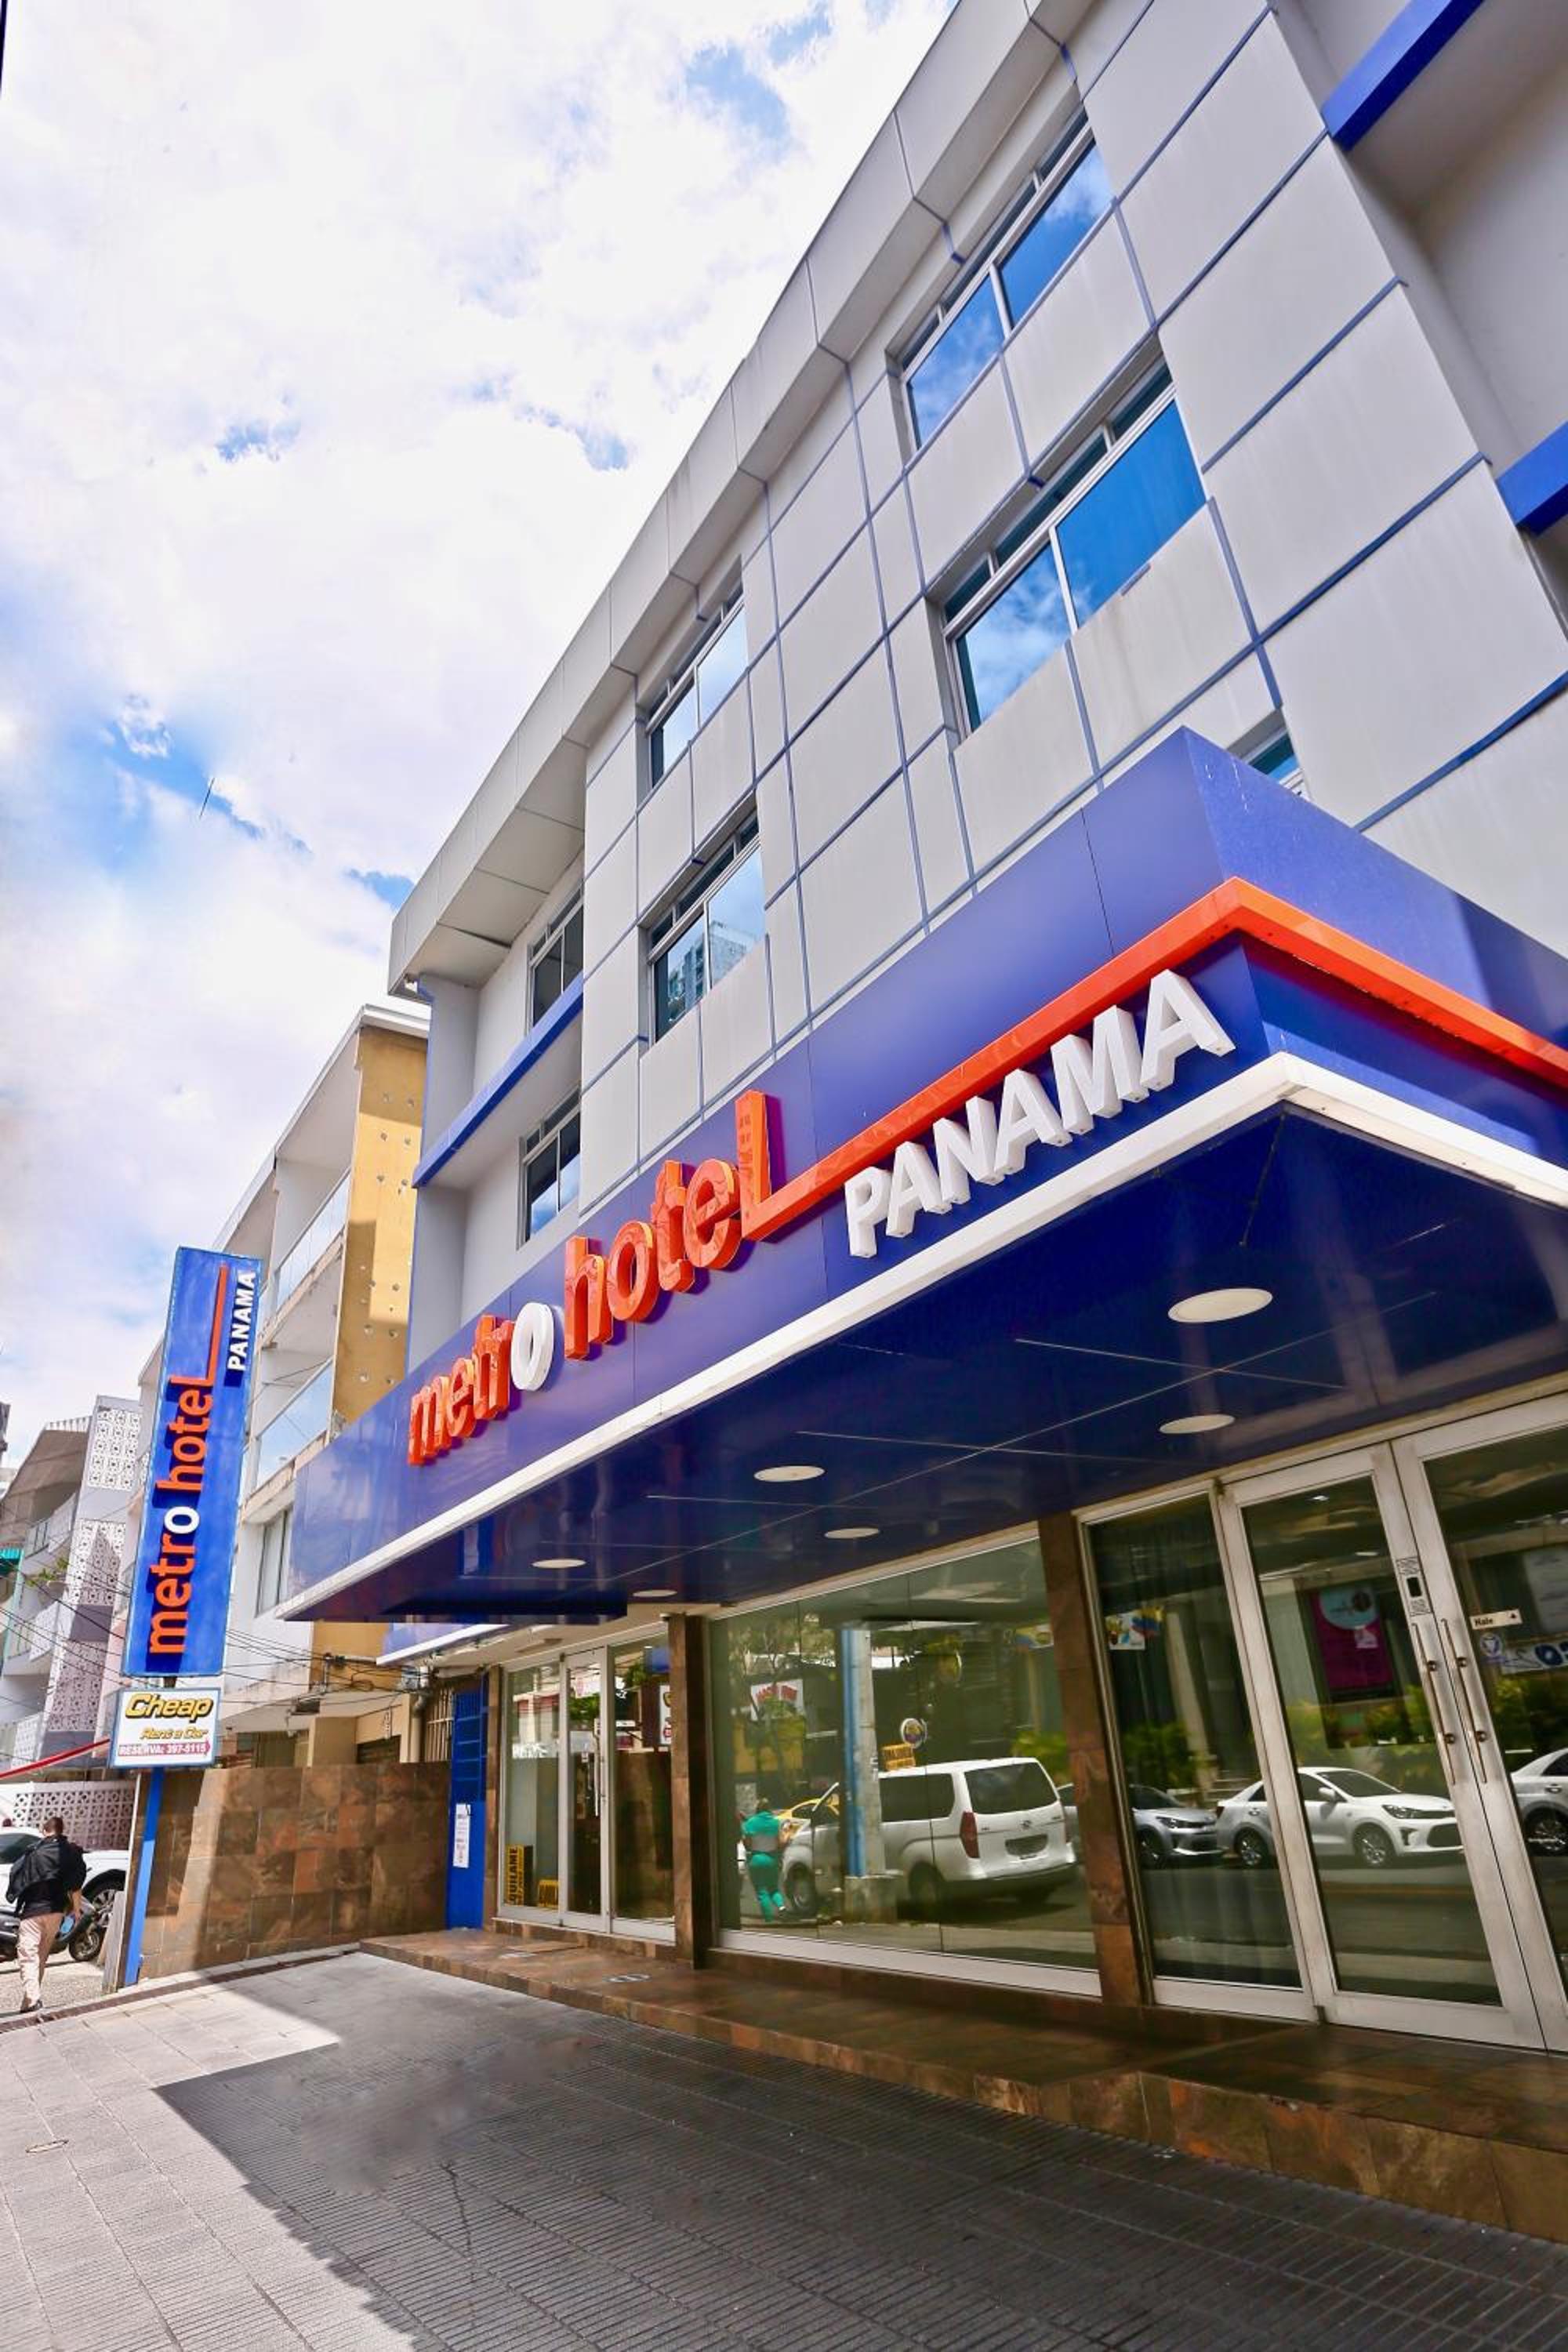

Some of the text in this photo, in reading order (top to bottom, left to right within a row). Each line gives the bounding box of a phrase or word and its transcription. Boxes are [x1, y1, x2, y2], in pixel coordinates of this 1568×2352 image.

[844, 969, 1236, 1258] PANAMA
[227, 1270, 256, 1372] PANAMA
[407, 1302, 554, 1466] metro
[149, 1505, 201, 1653] metro
[125, 1693, 214, 1723] Cheap
